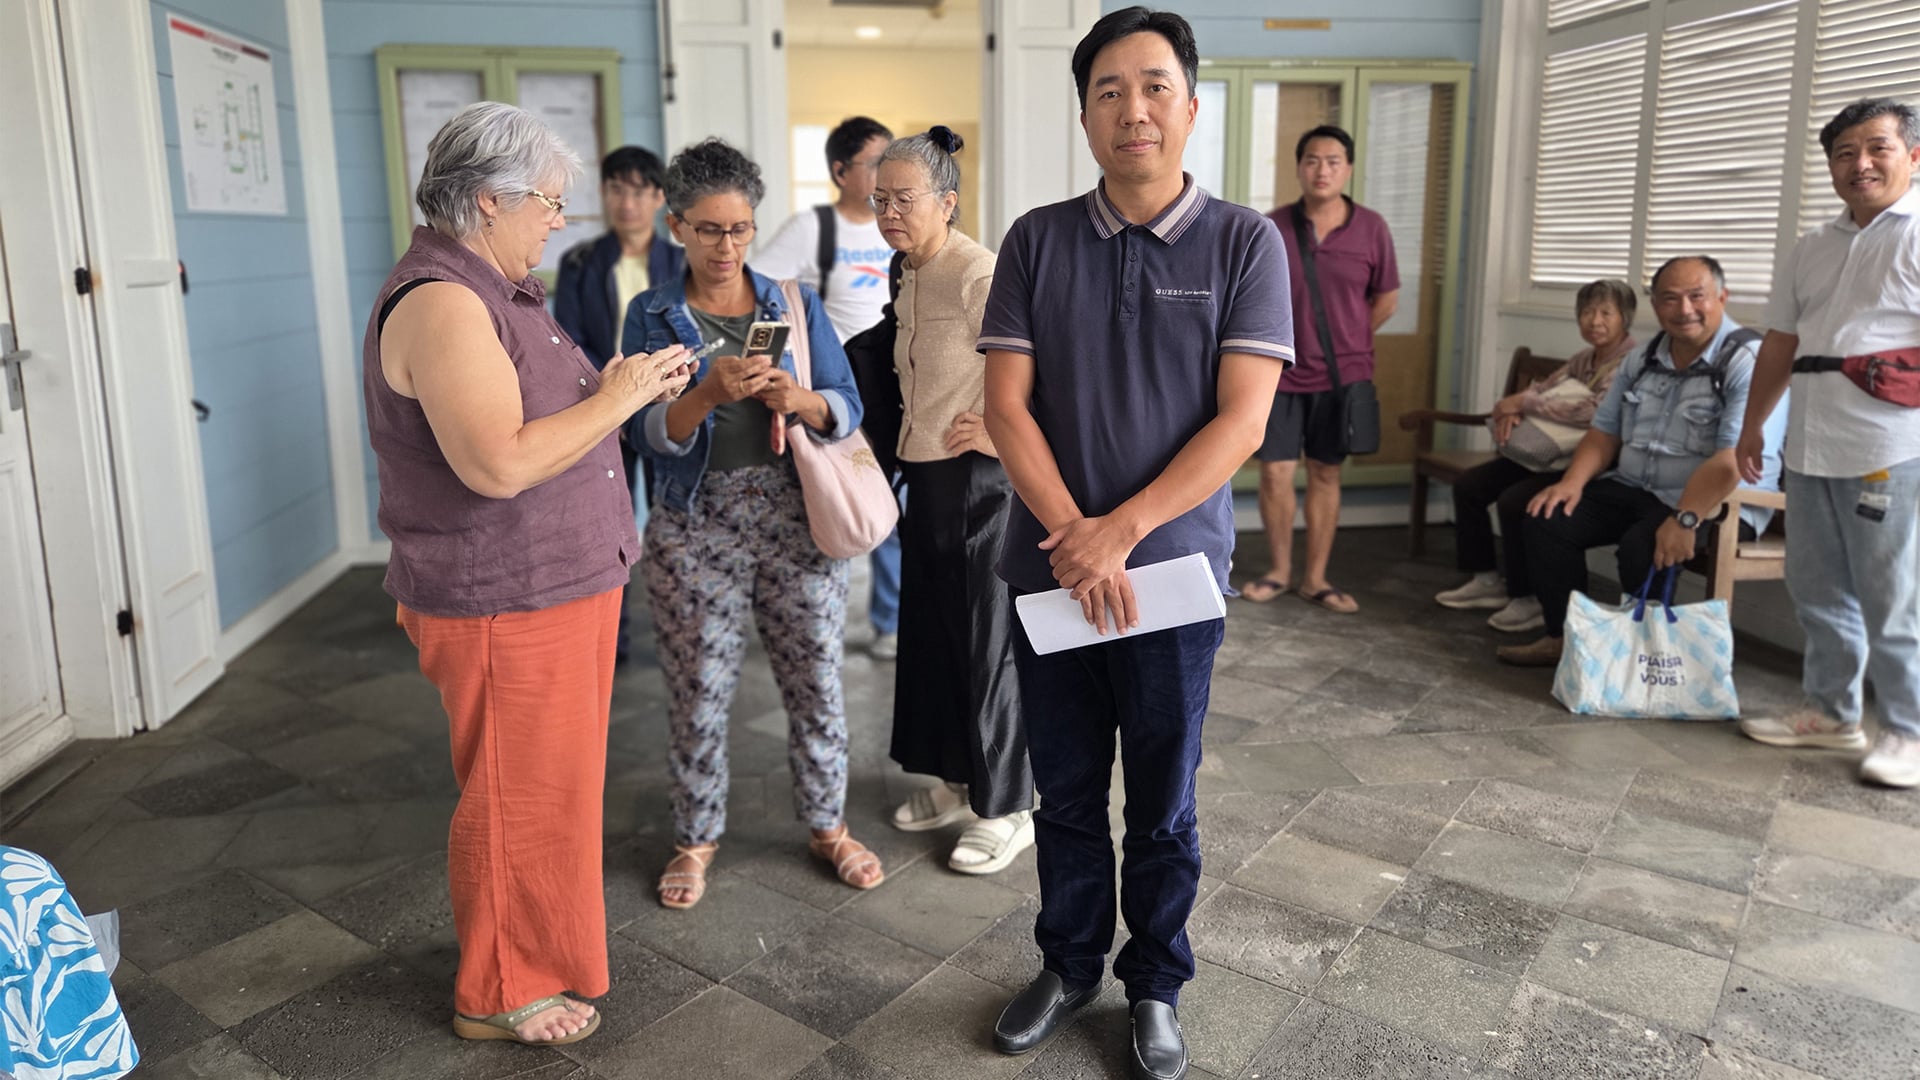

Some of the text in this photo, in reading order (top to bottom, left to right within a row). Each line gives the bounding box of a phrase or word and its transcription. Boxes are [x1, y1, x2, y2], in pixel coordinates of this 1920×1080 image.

[834, 246, 896, 264] Reebo
[1638, 654, 1682, 668] PLAISR
[1640, 672, 1678, 686] VOUS
